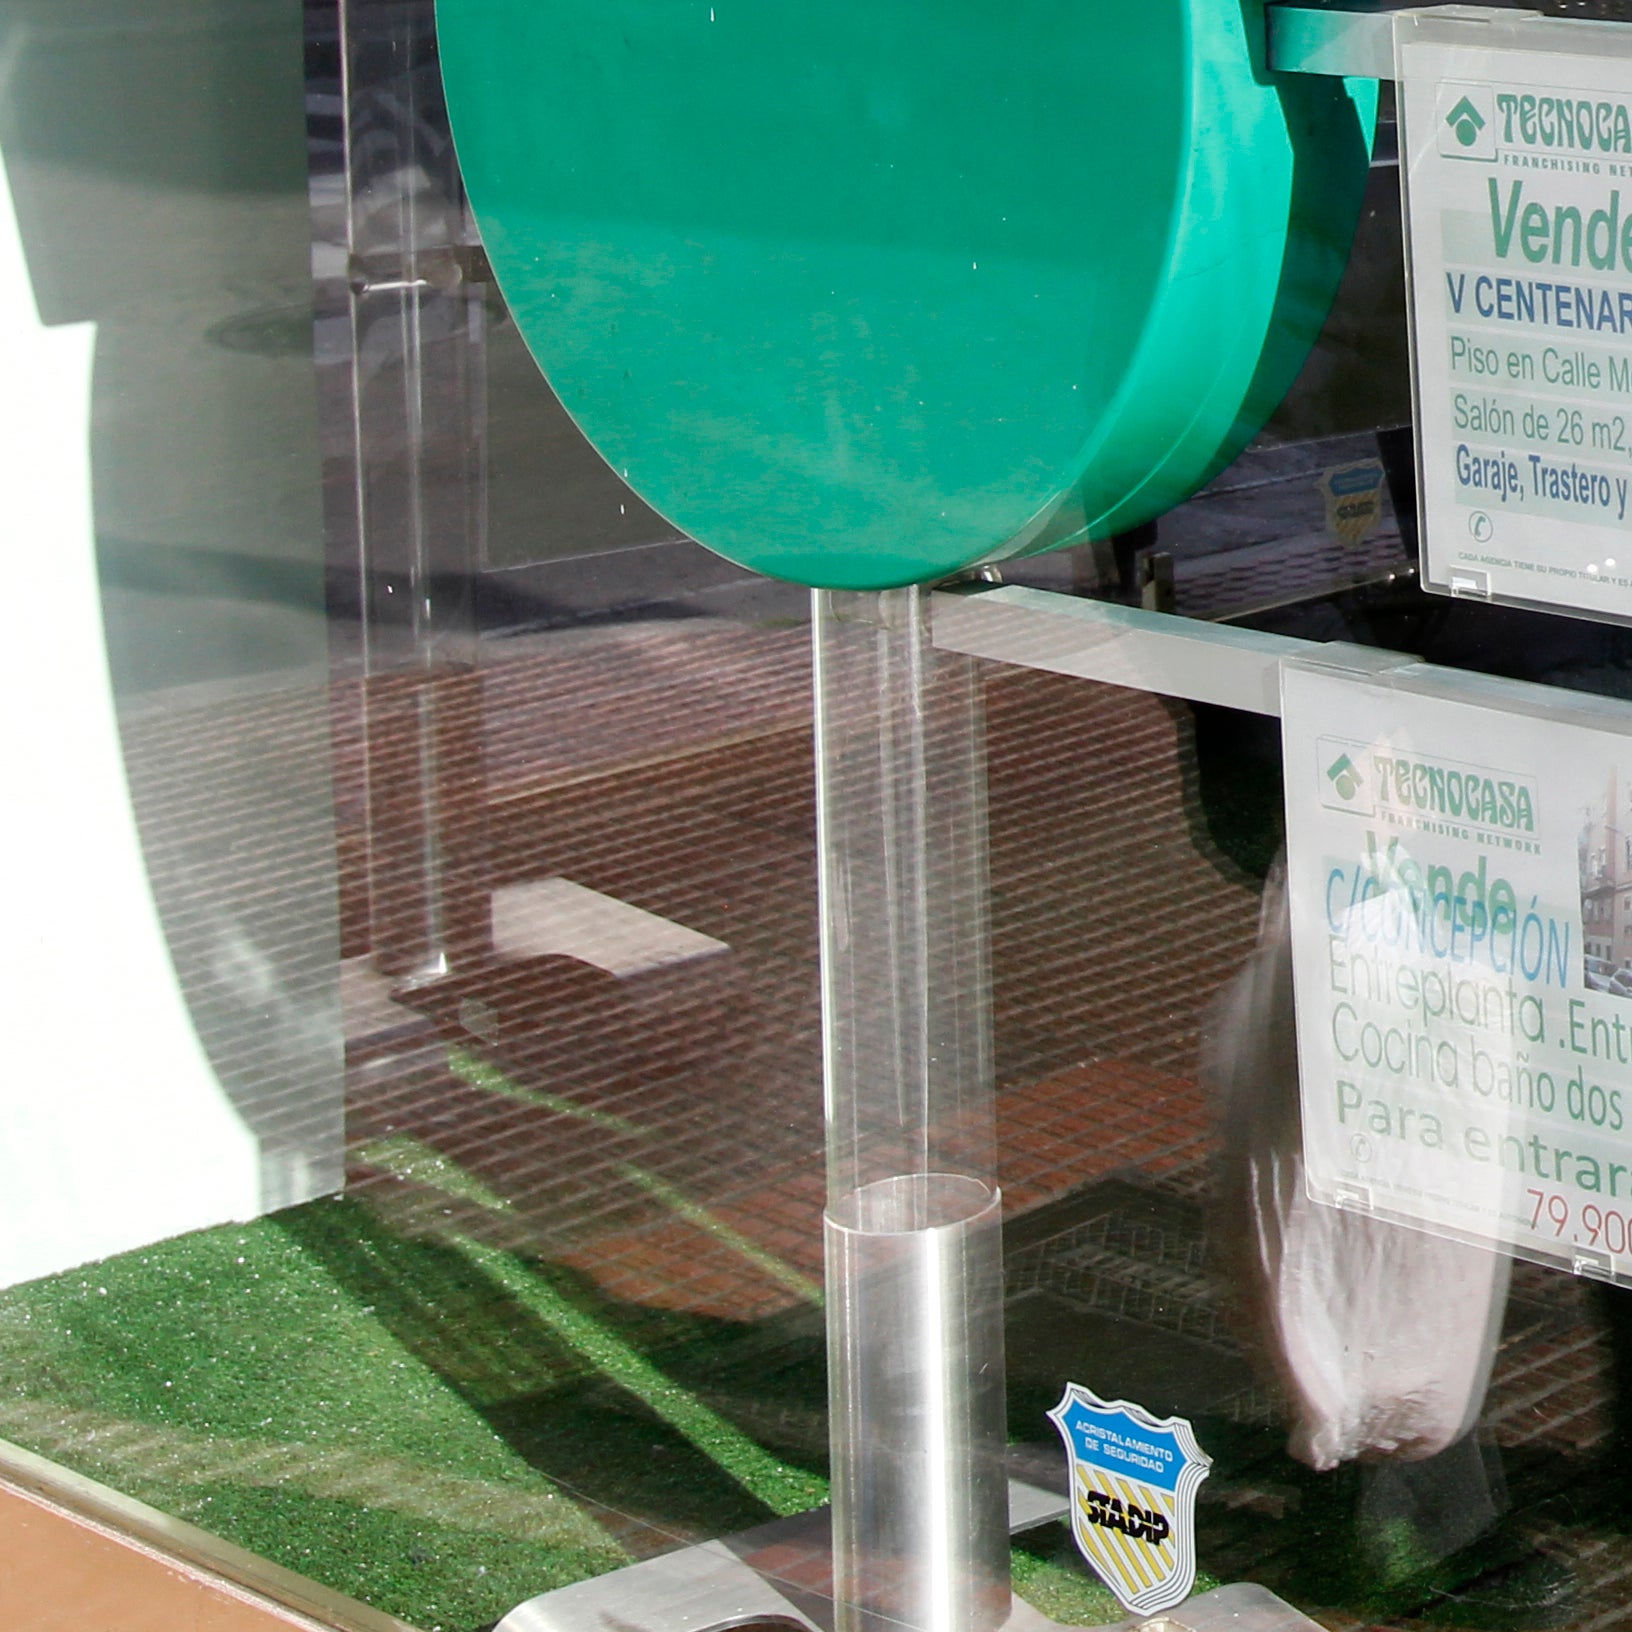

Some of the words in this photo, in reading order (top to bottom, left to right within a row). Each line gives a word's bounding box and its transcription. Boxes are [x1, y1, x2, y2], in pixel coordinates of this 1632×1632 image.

[1446, 273, 1466, 314] V
[1451, 337, 1500, 376] Piso
[1543, 346, 1601, 388] Calle
[1454, 395, 1515, 437] Salón
[1556, 409, 1584, 446] 26
[1455, 444, 1525, 505] Garaje,
[1528, 453, 1610, 506] Trastero
[1566, 1067, 1623, 1127] dos
[1075, 1421, 1173, 1462] ACRISTALAMIENTO
[1085, 1438, 1099, 1451] DE
[1103, 1445, 1164, 1473] SEGURIDAD
[1088, 1490, 1169, 1545] STADIP
